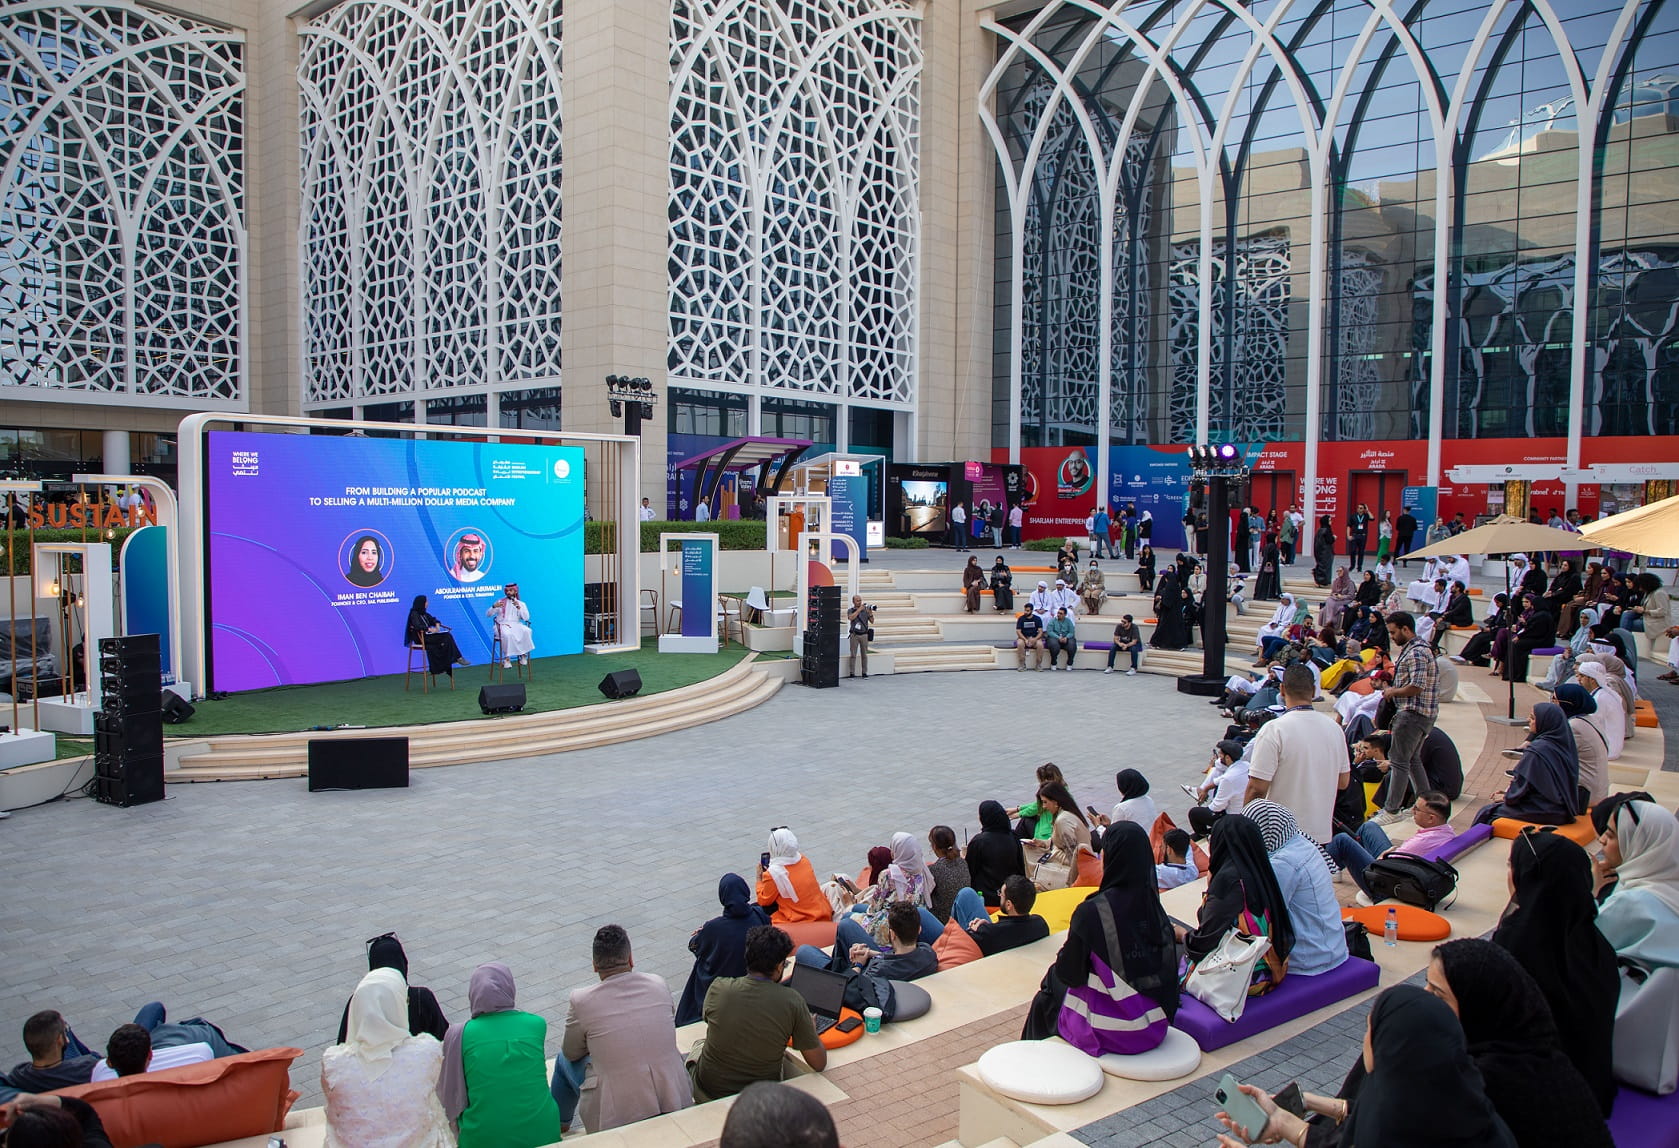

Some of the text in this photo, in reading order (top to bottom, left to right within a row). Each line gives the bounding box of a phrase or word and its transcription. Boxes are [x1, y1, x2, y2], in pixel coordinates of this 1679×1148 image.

[232, 456, 258, 464] BELONG
[1629, 465, 1657, 474] Catch
[1325, 477, 1337, 485] WE
[345, 487, 487, 496] FROM BUILDING A POPULAR PODCAST
[309, 497, 516, 506] TO SELLING A MULTI-MILLION DOLLAR MEDIA COMPANY
[27, 503, 157, 529] SUSTAIN
[435, 586, 476, 595] ABDULRAHMAN
[355, 592, 367, 600] BEN
[368, 591, 395, 599] CHAIBAH
